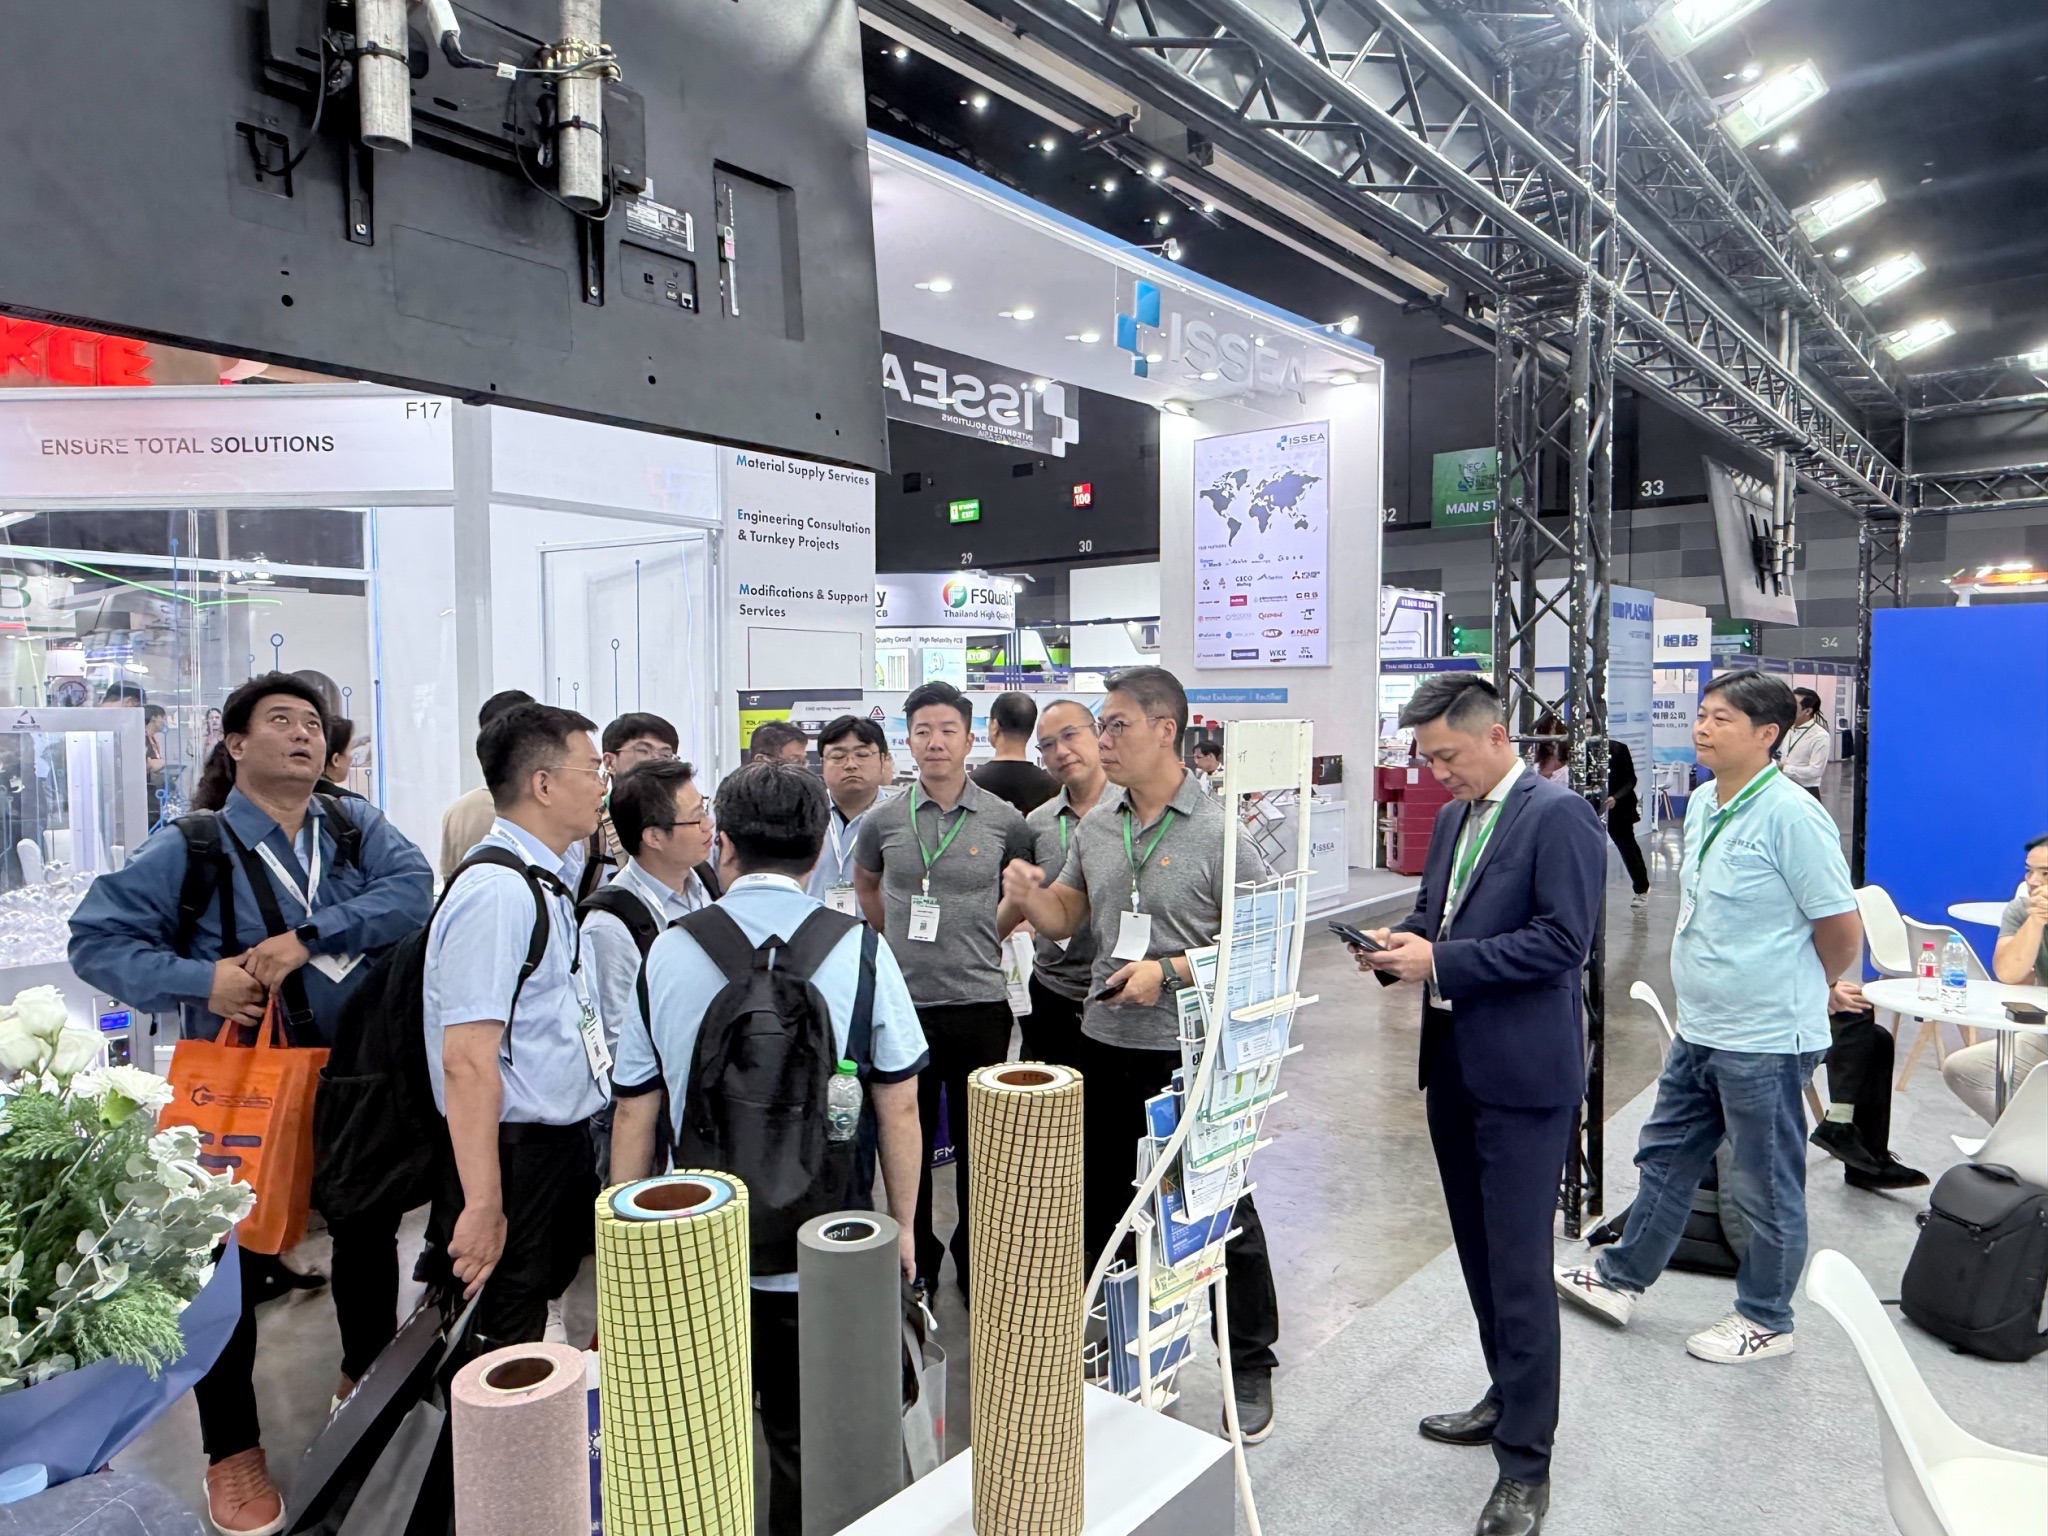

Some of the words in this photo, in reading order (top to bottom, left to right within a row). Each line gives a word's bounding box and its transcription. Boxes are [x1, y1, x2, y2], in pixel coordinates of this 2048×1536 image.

[1169, 312, 1307, 405] ISSEA
[405, 402, 442, 419] F17
[41, 438, 129, 455] ENSURE
[135, 437, 204, 454] TOTAL
[211, 435, 335, 453] SOLUTIONS
[1289, 432, 1325, 445] ISSEA
[736, 454, 785, 473] Material
[788, 462, 825, 482] Supply
[828, 469, 870, 485] Services
[1641, 480, 1664, 497] 33
[1075, 493, 1091, 505] 100
[1445, 501, 1479, 515] MAIN
[1482, 497, 1523, 511] STE
[737, 508, 804, 530] Engineering
[807, 517, 871, 535] Consultation
[738, 529, 747, 541] &
[750, 530, 795, 549] Turnkey
[798, 535, 840, 551] Projects
[1079, 540, 1092, 552] 30
[961, 552, 973, 564] 29
[739, 583, 814, 599] Modifications
[817, 589, 825, 600] &
[827, 589, 868, 605] Support
[739, 604, 786, 617] Services
[944, 609, 978, 618] Thailand
[980, 611, 995, 620] High
[1821, 637, 1839, 648] 34
[1269, 649, 1287, 657] WKK
